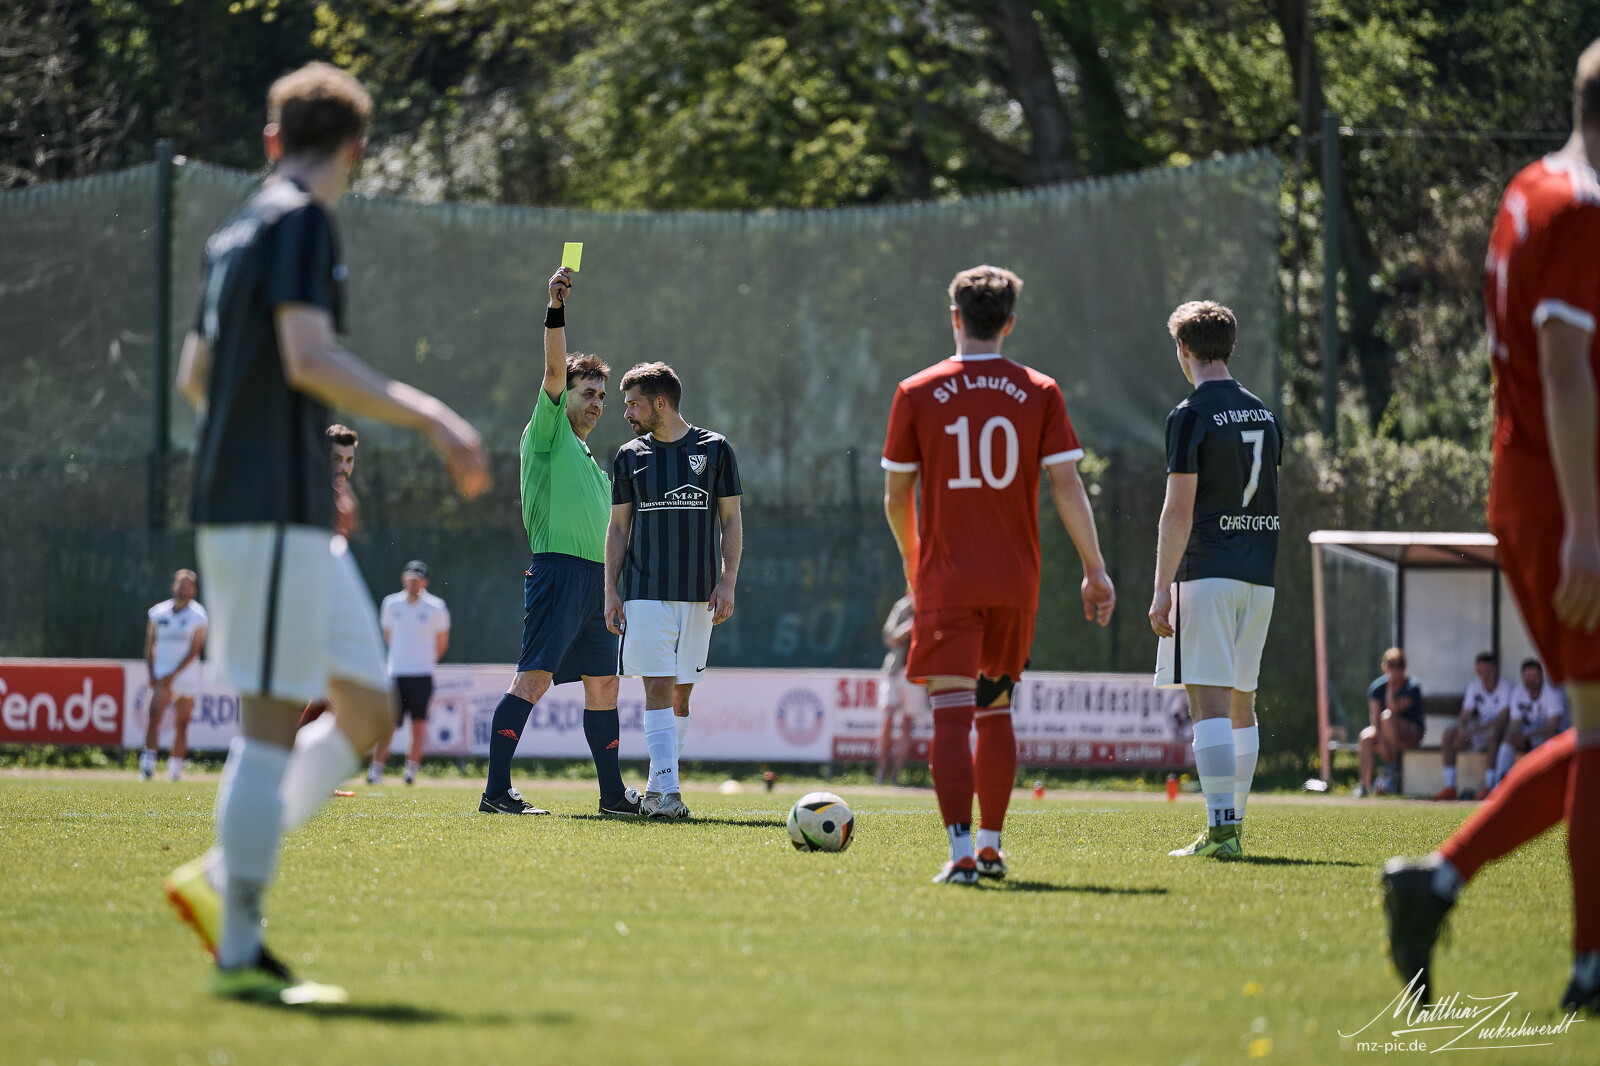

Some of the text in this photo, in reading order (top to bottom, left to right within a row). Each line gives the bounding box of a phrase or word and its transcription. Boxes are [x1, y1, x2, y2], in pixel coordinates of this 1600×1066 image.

[933, 374, 1028, 404] SV Laufen
[1213, 411, 1228, 426] SV
[944, 415, 1020, 490] 10
[1240, 429, 1265, 508] 7
[640, 499, 704, 508] Hausverwaltungen
[672, 492, 703, 500] M&P
